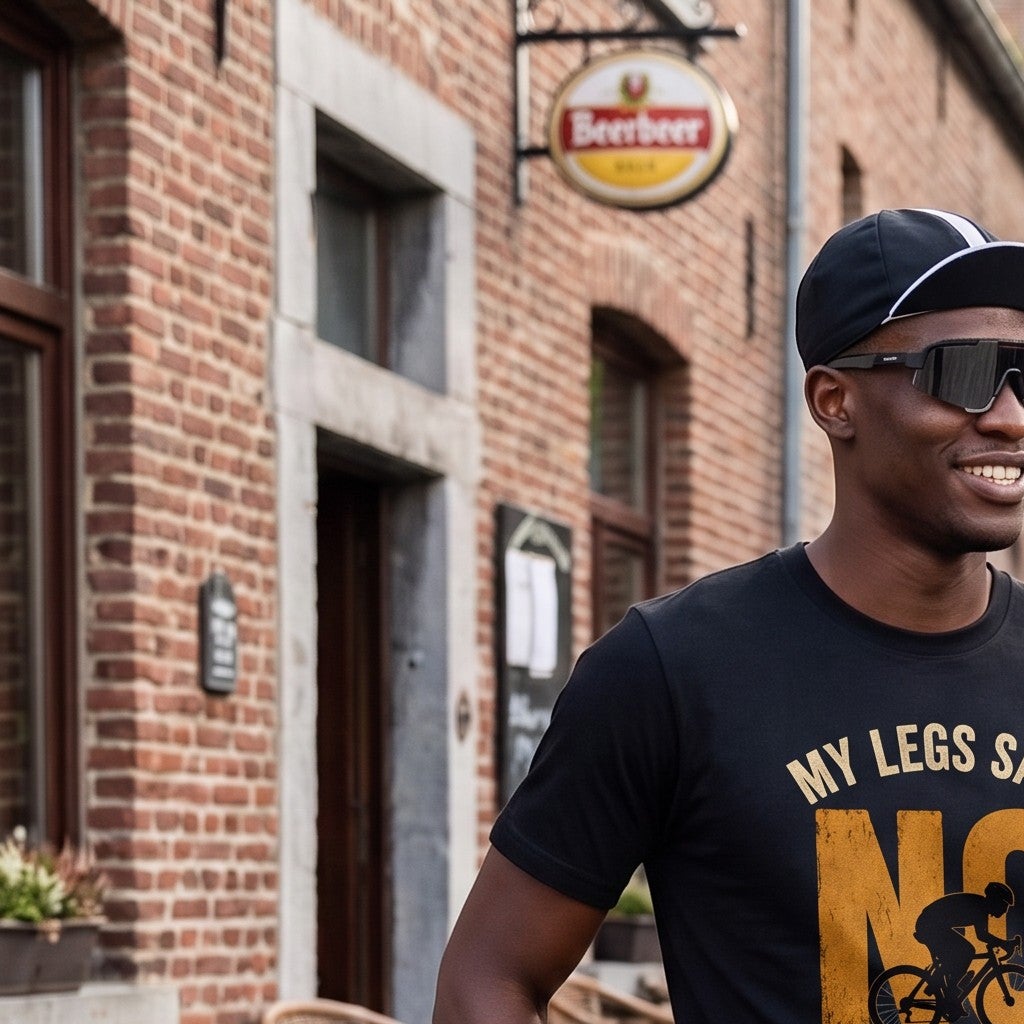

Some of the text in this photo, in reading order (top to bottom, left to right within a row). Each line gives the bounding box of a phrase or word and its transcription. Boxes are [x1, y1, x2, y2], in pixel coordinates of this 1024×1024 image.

[570, 109, 704, 148] Beerbeer
[786, 736, 857, 805] MY
[869, 722, 976, 778] LEGS
